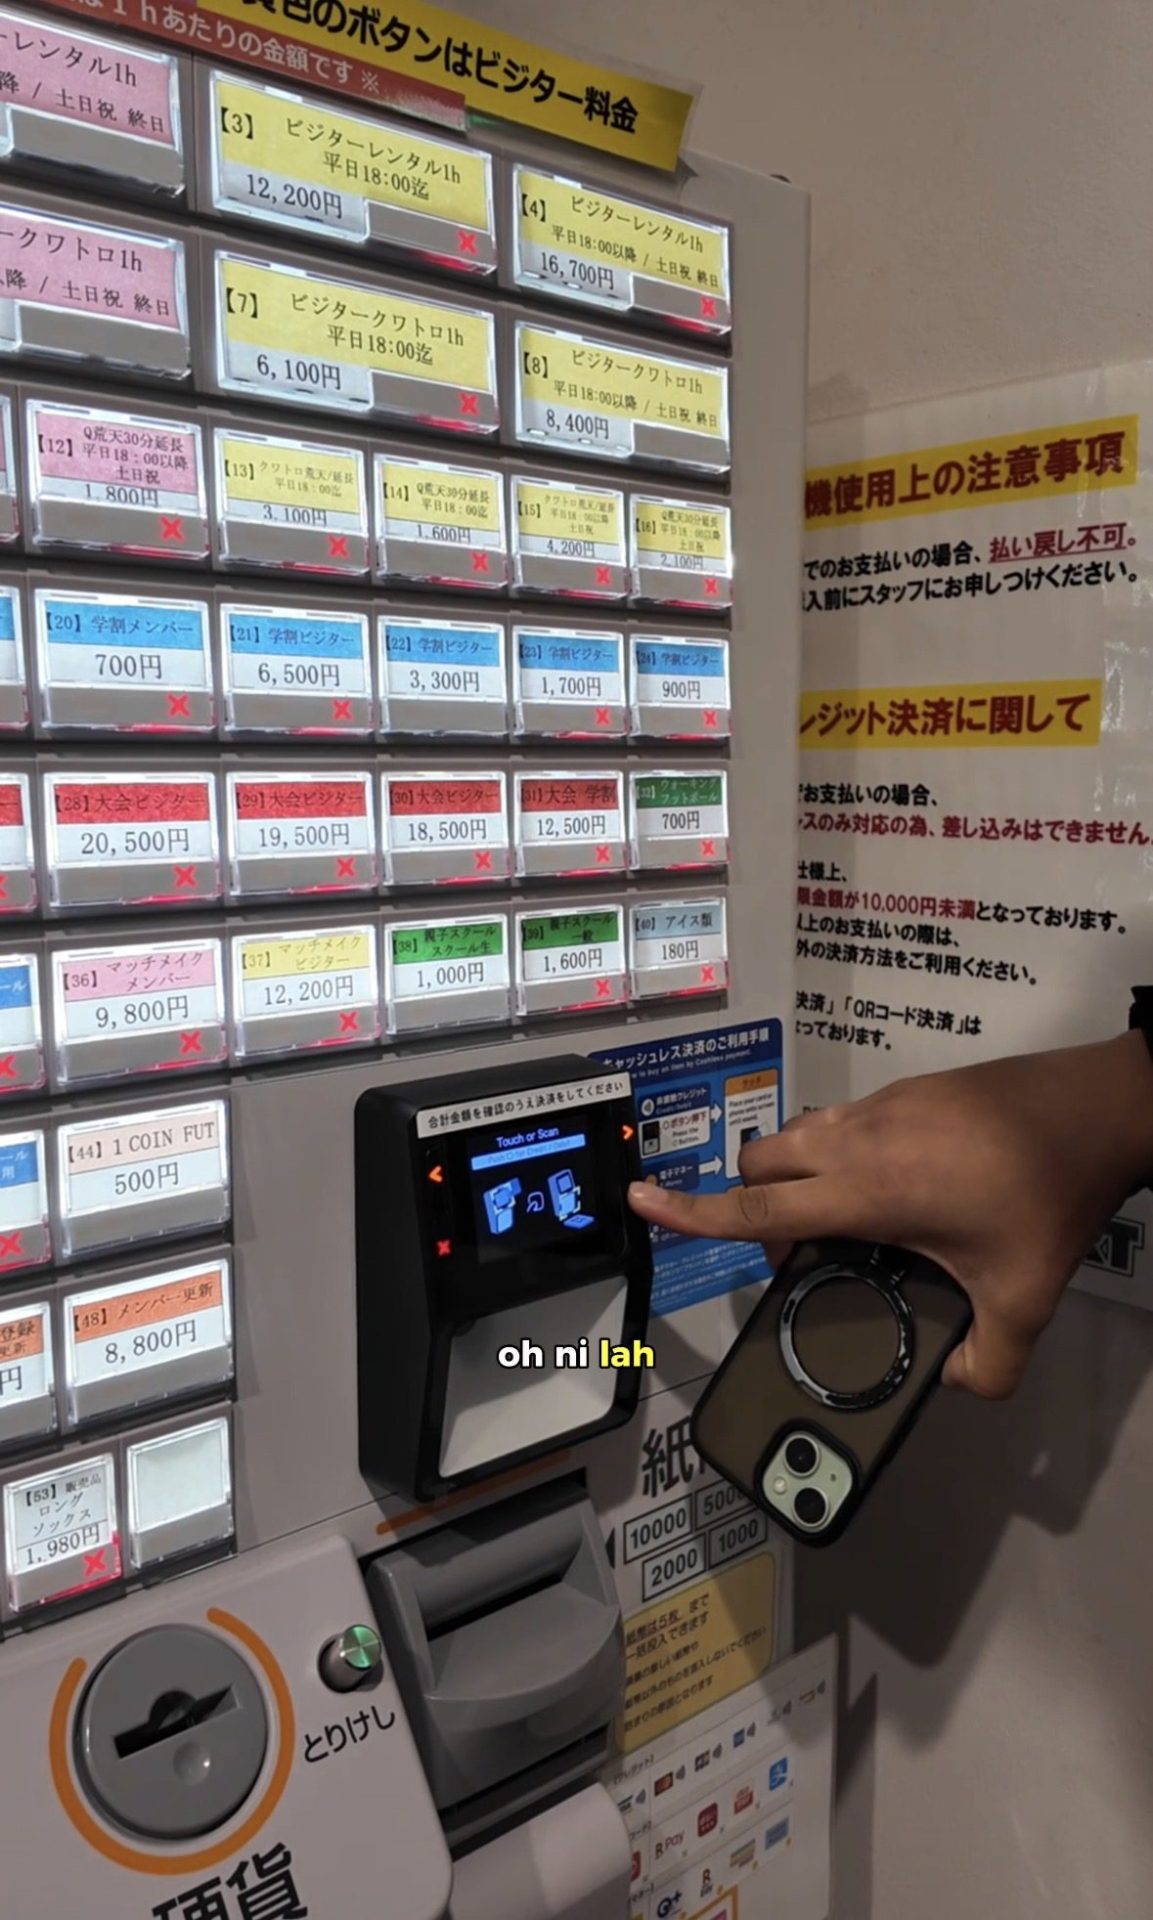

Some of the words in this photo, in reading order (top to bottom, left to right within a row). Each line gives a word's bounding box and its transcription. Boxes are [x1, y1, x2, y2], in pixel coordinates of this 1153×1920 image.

[56, 88, 117, 122] 土日祝
[128, 107, 164, 133] 終日
[221, 107, 254, 140] 【3】
[286, 117, 461, 185] ビジターレンタル1h
[323, 151, 430, 200] 平日18:00迄
[247, 173, 343, 220] 12,200円
[522, 194, 546, 222] 【4】
[571, 195, 703, 253] ビジターレンタル1h
[541, 252, 614, 291] 16,700円
[62, 280, 124, 309] 土日祝
[134, 293, 170, 316] 終日
[226, 287, 258, 319] 【7】
[290, 292, 464, 347] ビジタークワトロ1h
[327, 323, 433, 366] 平日18:00迄
[256, 353, 342, 391] 6,100円
[524, 352, 548, 379] 【8】
[572, 349, 703, 395] ビジタークワトロ1h
[546, 408, 609, 440] 8,400円
[37, 434, 73, 457] 【12】
[224, 459, 254, 481] 【13】
[804, 431, 1126, 519] 機使用上の注意事項
[383, 482, 409, 502] 【14】
[518, 500, 541, 519] 【15】
[802, 561, 1137, 612] 入前にスタッフにお申しつけください。
[46, 612, 81, 633] 【20】
[90, 615, 194, 635] 学割メンバー
[229, 625, 260, 644] 【21】
[268, 627, 355, 646] 学割ビジター
[385, 636, 414, 653] 【22】
[95, 653, 163, 681] 700円
[257, 662, 341, 688] 6,500円
[409, 669, 480, 693] 3,300円
[541, 675, 601, 698] 1,700円
[662, 680, 700, 700] 900円
[55, 793, 90, 813] 【28】
[95, 792, 206, 813] 大会ビジター
[268, 789, 363, 809] 大会ビジター
[546, 786, 577, 805] 大会
[798, 783, 938, 806] お支払いの場合、
[408, 818, 487, 844] 18,500円
[537, 814, 606, 839] 12,500円
[662, 810, 700, 830] 700円
[80, 827, 190, 857] 20,500円
[258, 822, 350, 849] 19,500円
[796, 912, 960, 948] 上のお支払いの際は、
[107, 952, 203, 974] マッチメイク
[241, 949, 271, 971] 【37】
[543, 947, 602, 973] 1,600円
[661, 940, 699, 961] 180円
[63, 969, 98, 991] 【36】
[127, 975, 190, 993] メンバー
[417, 962, 484, 989] 1,000円
[264, 975, 354, 1007] 12,200円
[95, 995, 189, 1031] 9,800円
[428, 1081, 623, 1129] 合計金額を確認のうえ決済をしてください
[68, 1140, 102, 1165] 【44】
[113, 1138, 122, 1157] 1
[128, 1128, 174, 1153] COIN
[183, 1120, 214, 1143] FUT
[496, 1133, 525, 1148] Touch
[526, 1132, 535, 1142] or
[537, 1127, 560, 1140] Scan
[114, 1162, 180, 1197] 500円
[71, 1308, 108, 1334] 【48】
[118, 1280, 214, 1321] メンバー更新
[105, 1319, 197, 1366] 8,800円
[26, 1484, 56, 1507] 【53】
[40, 1492, 83, 1517] ロング
[33, 1508, 92, 1538] ソックス
[630, 1508, 687, 1549] 10000
[651, 1548, 698, 1588] 2000
[718, 1518, 758, 1554] 1000
[303, 1705, 396, 1764] とりけし
